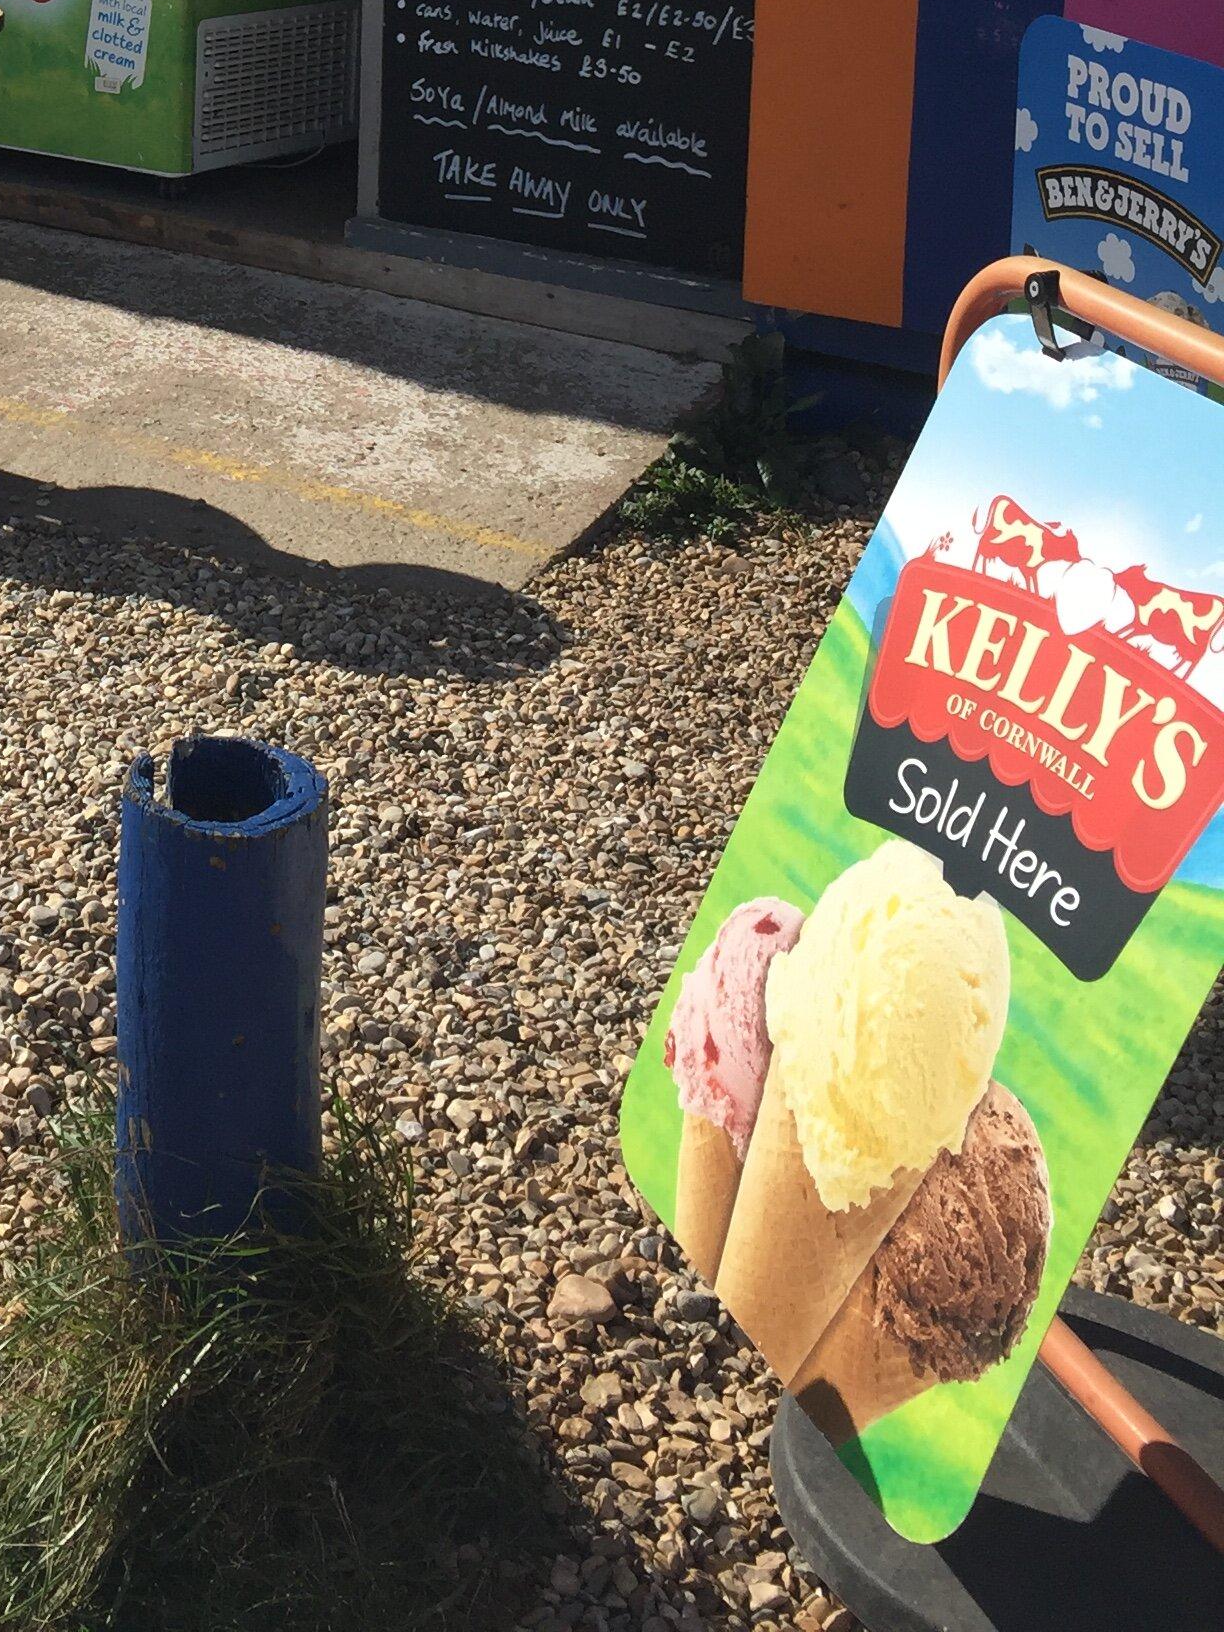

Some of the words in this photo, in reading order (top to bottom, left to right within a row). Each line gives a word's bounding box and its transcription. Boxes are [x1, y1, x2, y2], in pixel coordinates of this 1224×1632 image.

[92, 28, 143, 54] clotted
[98, 11, 125, 28] milk
[127, 17, 145, 36] &
[123, 0, 147, 16] local
[94, 49, 135, 70] cream
[1067, 53, 1192, 136] PROUD
[616, 119, 708, 158] available
[1065, 102, 1109, 151] TO
[1114, 121, 1189, 183] SELL
[433, 150, 497, 188] TAKE
[509, 167, 571, 216] AWAY
[588, 190, 647, 228] ONLY
[904, 588, 1208, 811] KELLY'S
[946, 693, 978, 726] OF
[978, 707, 1096, 801] CORNWALL
[888, 756, 988, 849] Sold
[981, 805, 1081, 927] Here
